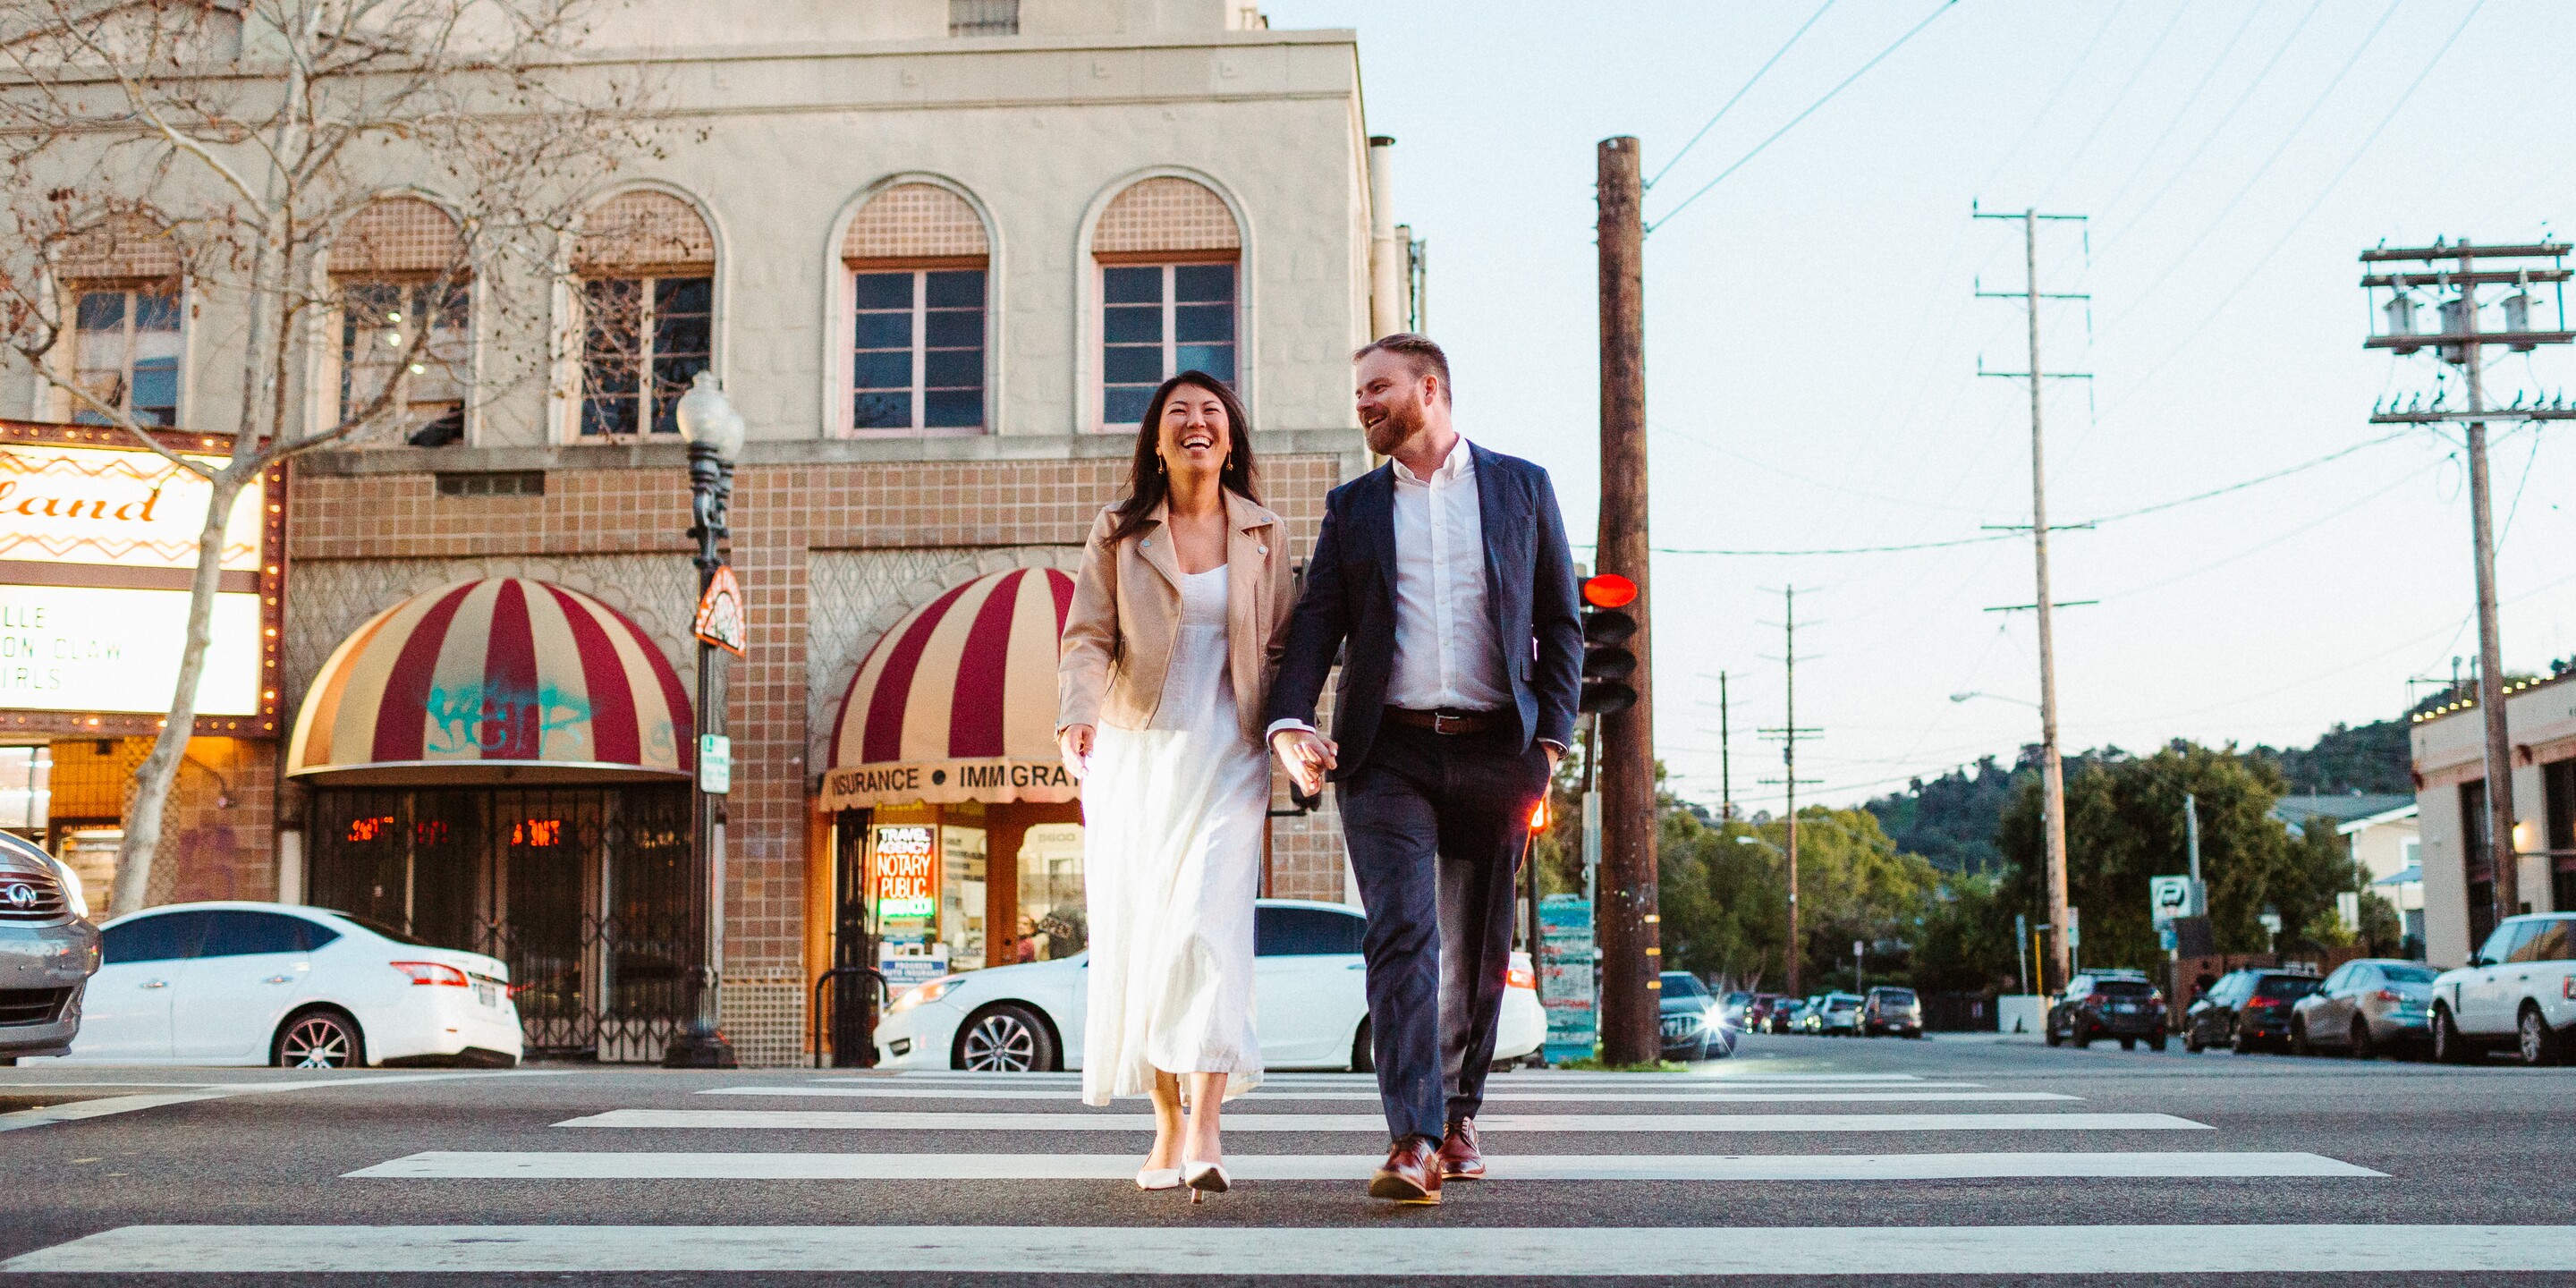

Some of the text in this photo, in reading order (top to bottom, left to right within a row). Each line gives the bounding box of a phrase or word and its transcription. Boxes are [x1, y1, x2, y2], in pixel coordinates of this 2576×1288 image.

[960, 765, 1079, 787] IMMGRA
[879, 827, 930, 842] TRAVEL
[877, 840, 931, 854] AGENCY
[877, 854, 931, 877] NOTARY
[880, 877, 927, 899] PUBLIC
